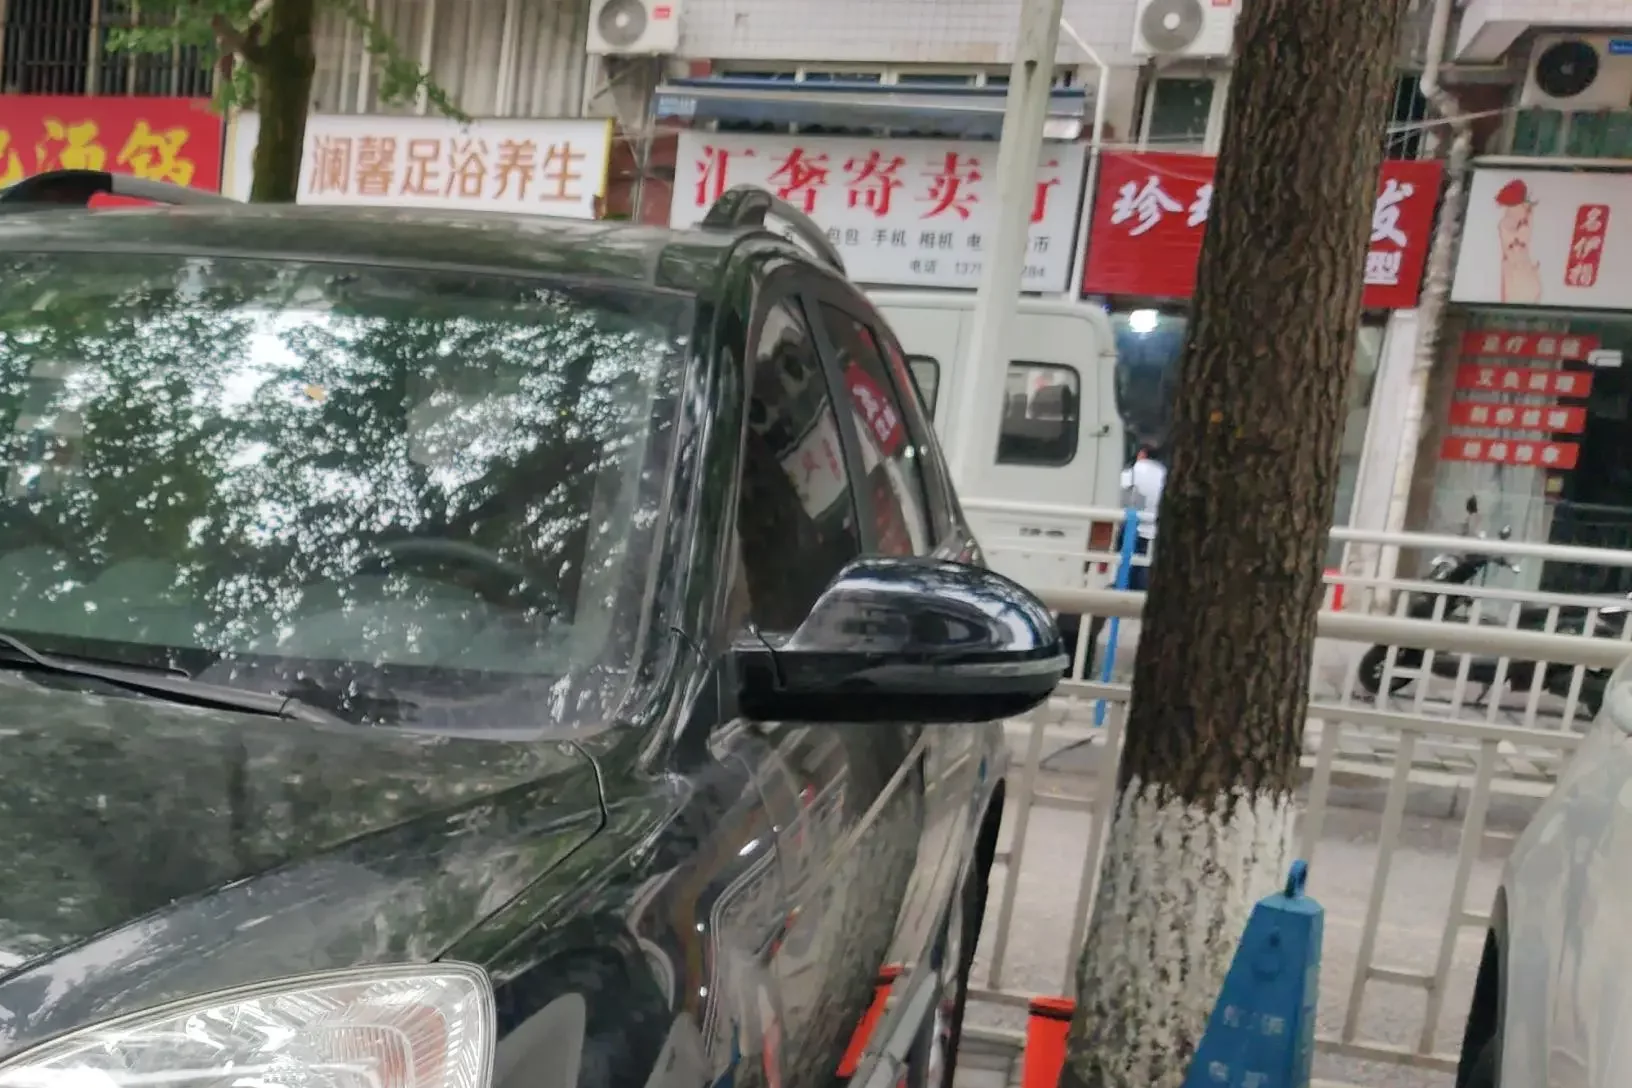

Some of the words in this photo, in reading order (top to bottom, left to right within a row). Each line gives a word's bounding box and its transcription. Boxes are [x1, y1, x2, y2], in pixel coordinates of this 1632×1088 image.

[309, 134, 586, 202] 澜馨足浴养生
[871, 228, 907, 248] 手机
[909, 259, 938, 275] 电话
